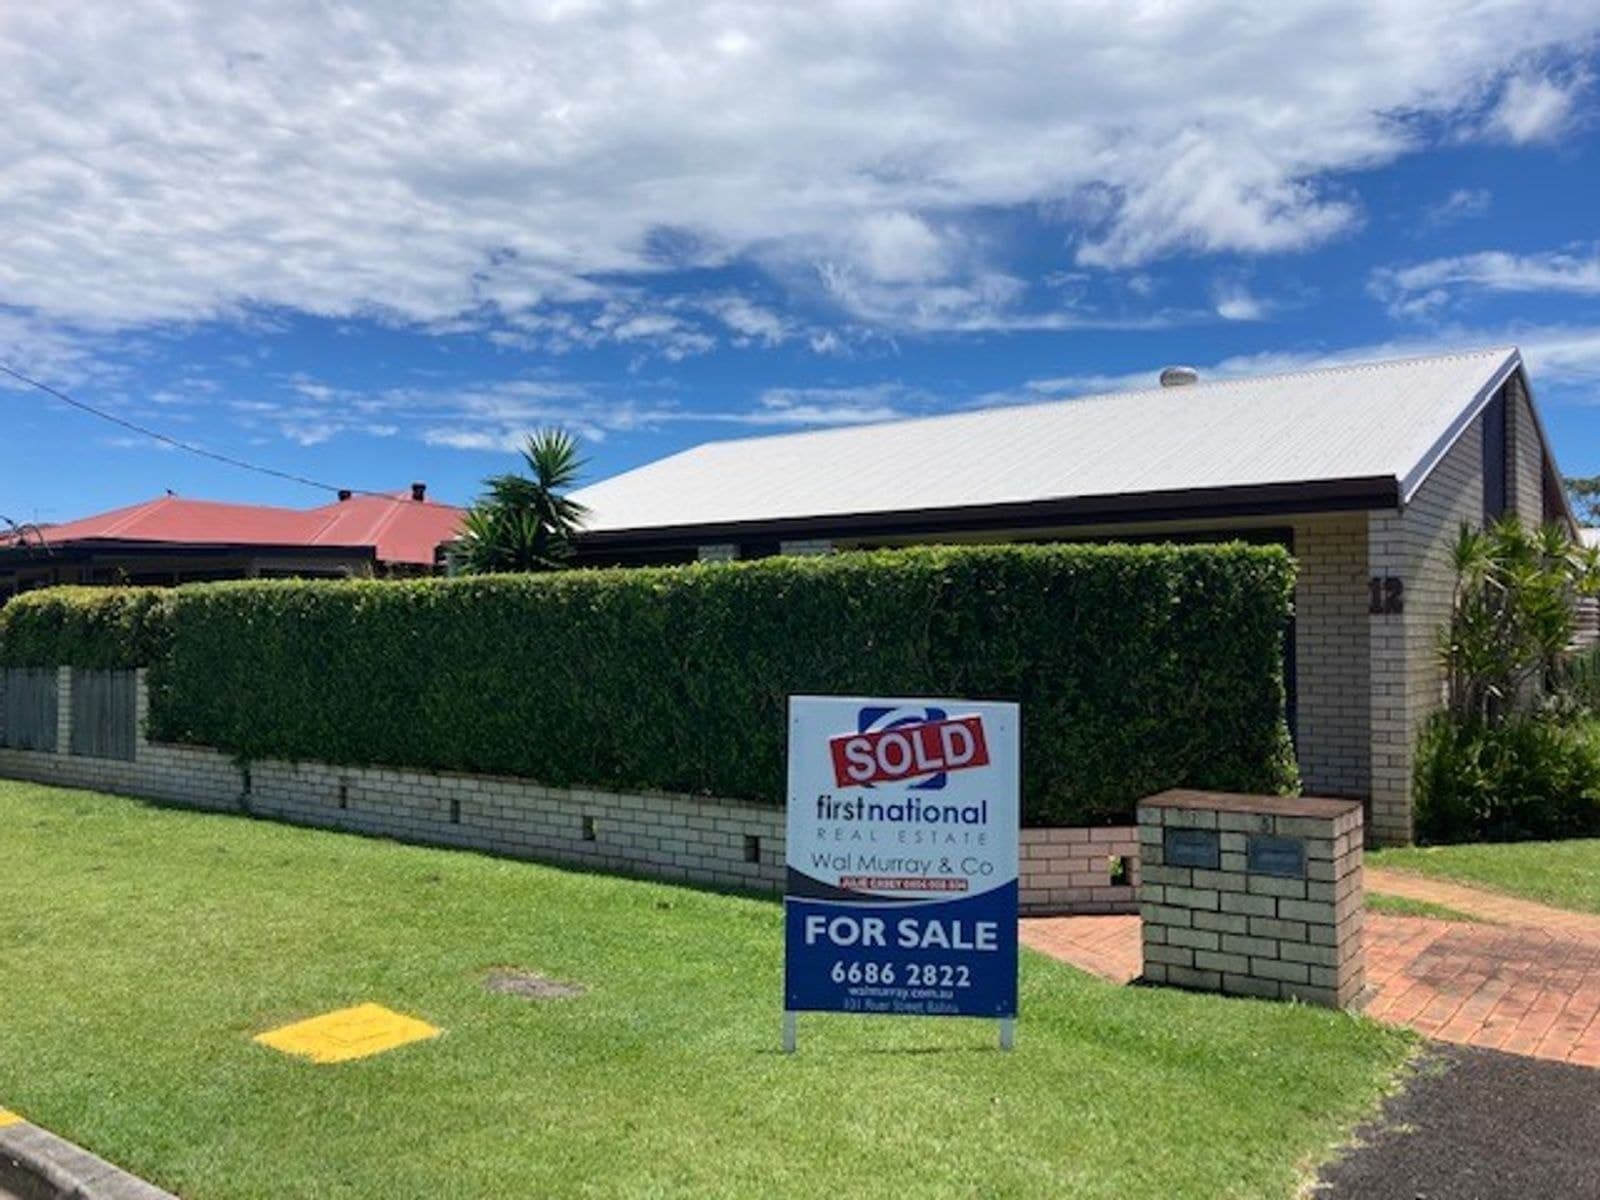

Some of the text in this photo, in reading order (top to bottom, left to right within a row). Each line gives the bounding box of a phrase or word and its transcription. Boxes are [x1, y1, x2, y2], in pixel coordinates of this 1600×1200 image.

[1368, 577, 1403, 614] 12
[845, 723, 975, 781] SOLD
[818, 828, 986, 845] REAL ESTATE
[812, 853, 993, 876] Wal Murray & Co
[805, 915, 998, 950] FOR SALE
[831, 961, 971, 987] 6686 2822
[848, 986, 954, 1000] walmurray.com.au
